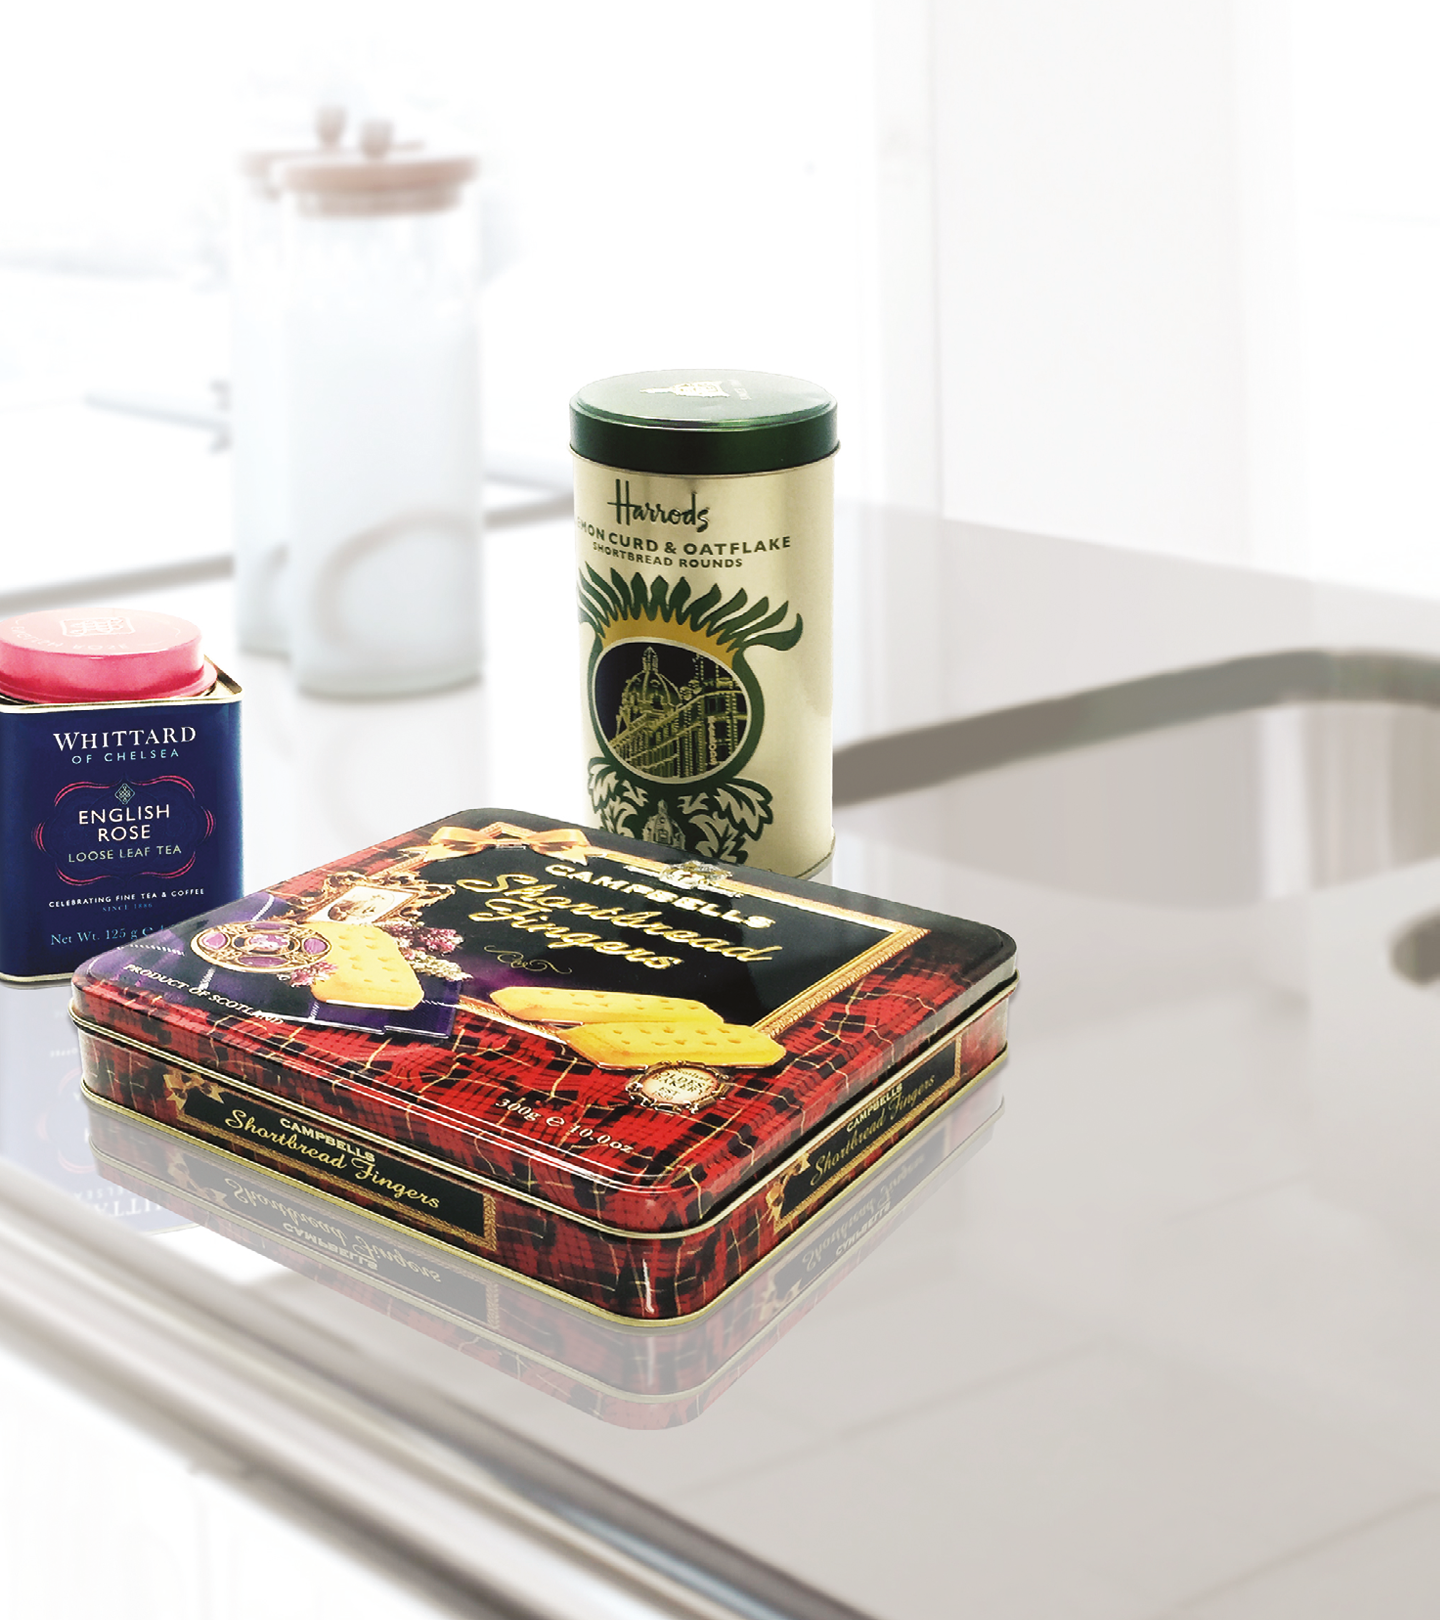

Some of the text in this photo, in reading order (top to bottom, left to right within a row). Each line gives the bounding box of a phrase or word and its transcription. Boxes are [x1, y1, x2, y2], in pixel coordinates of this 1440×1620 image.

[607, 479, 710, 533] Harrods
[592, 541, 743, 568] SHORTBREAD ROUNDS
[608, 532, 659, 552] CURD
[664, 541, 678, 554] &
[683, 536, 791, 556] OATFLAKE
[52, 726, 196, 751] WHITTARD
[71, 748, 179, 765] OF CHELSEA
[79, 804, 170, 825] ENGLISH
[98, 824, 151, 842] ROSE
[68, 844, 182, 863] LOOSE LEAF TEA
[48, 896, 111, 908] CELEBRATING
[115, 893, 136, 901] FINE
[141, 892, 158, 900] TEA
[171, 888, 205, 897] COFFEE
[545, 864, 776, 929] CAMPBELLS
[456, 873, 783, 962] Shortbread
[50, 933, 72, 946] Net
[77, 931, 100, 942] Wt.
[106, 928, 126, 940] 125
[130, 929, 138, 940] g
[468, 898, 683, 969] Fingers
[123, 964, 284, 1025] PRODUCT OF SCOTLAND
[495, 1098, 542, 1122] 300g
[846, 1082, 903, 1133] CAMPBELLS
[279, 1117, 376, 1163] CAMPBELLS
[810, 1075, 935, 1186] Shortbread Fingers
[224, 1109, 441, 1209] Shortbread Fingers
